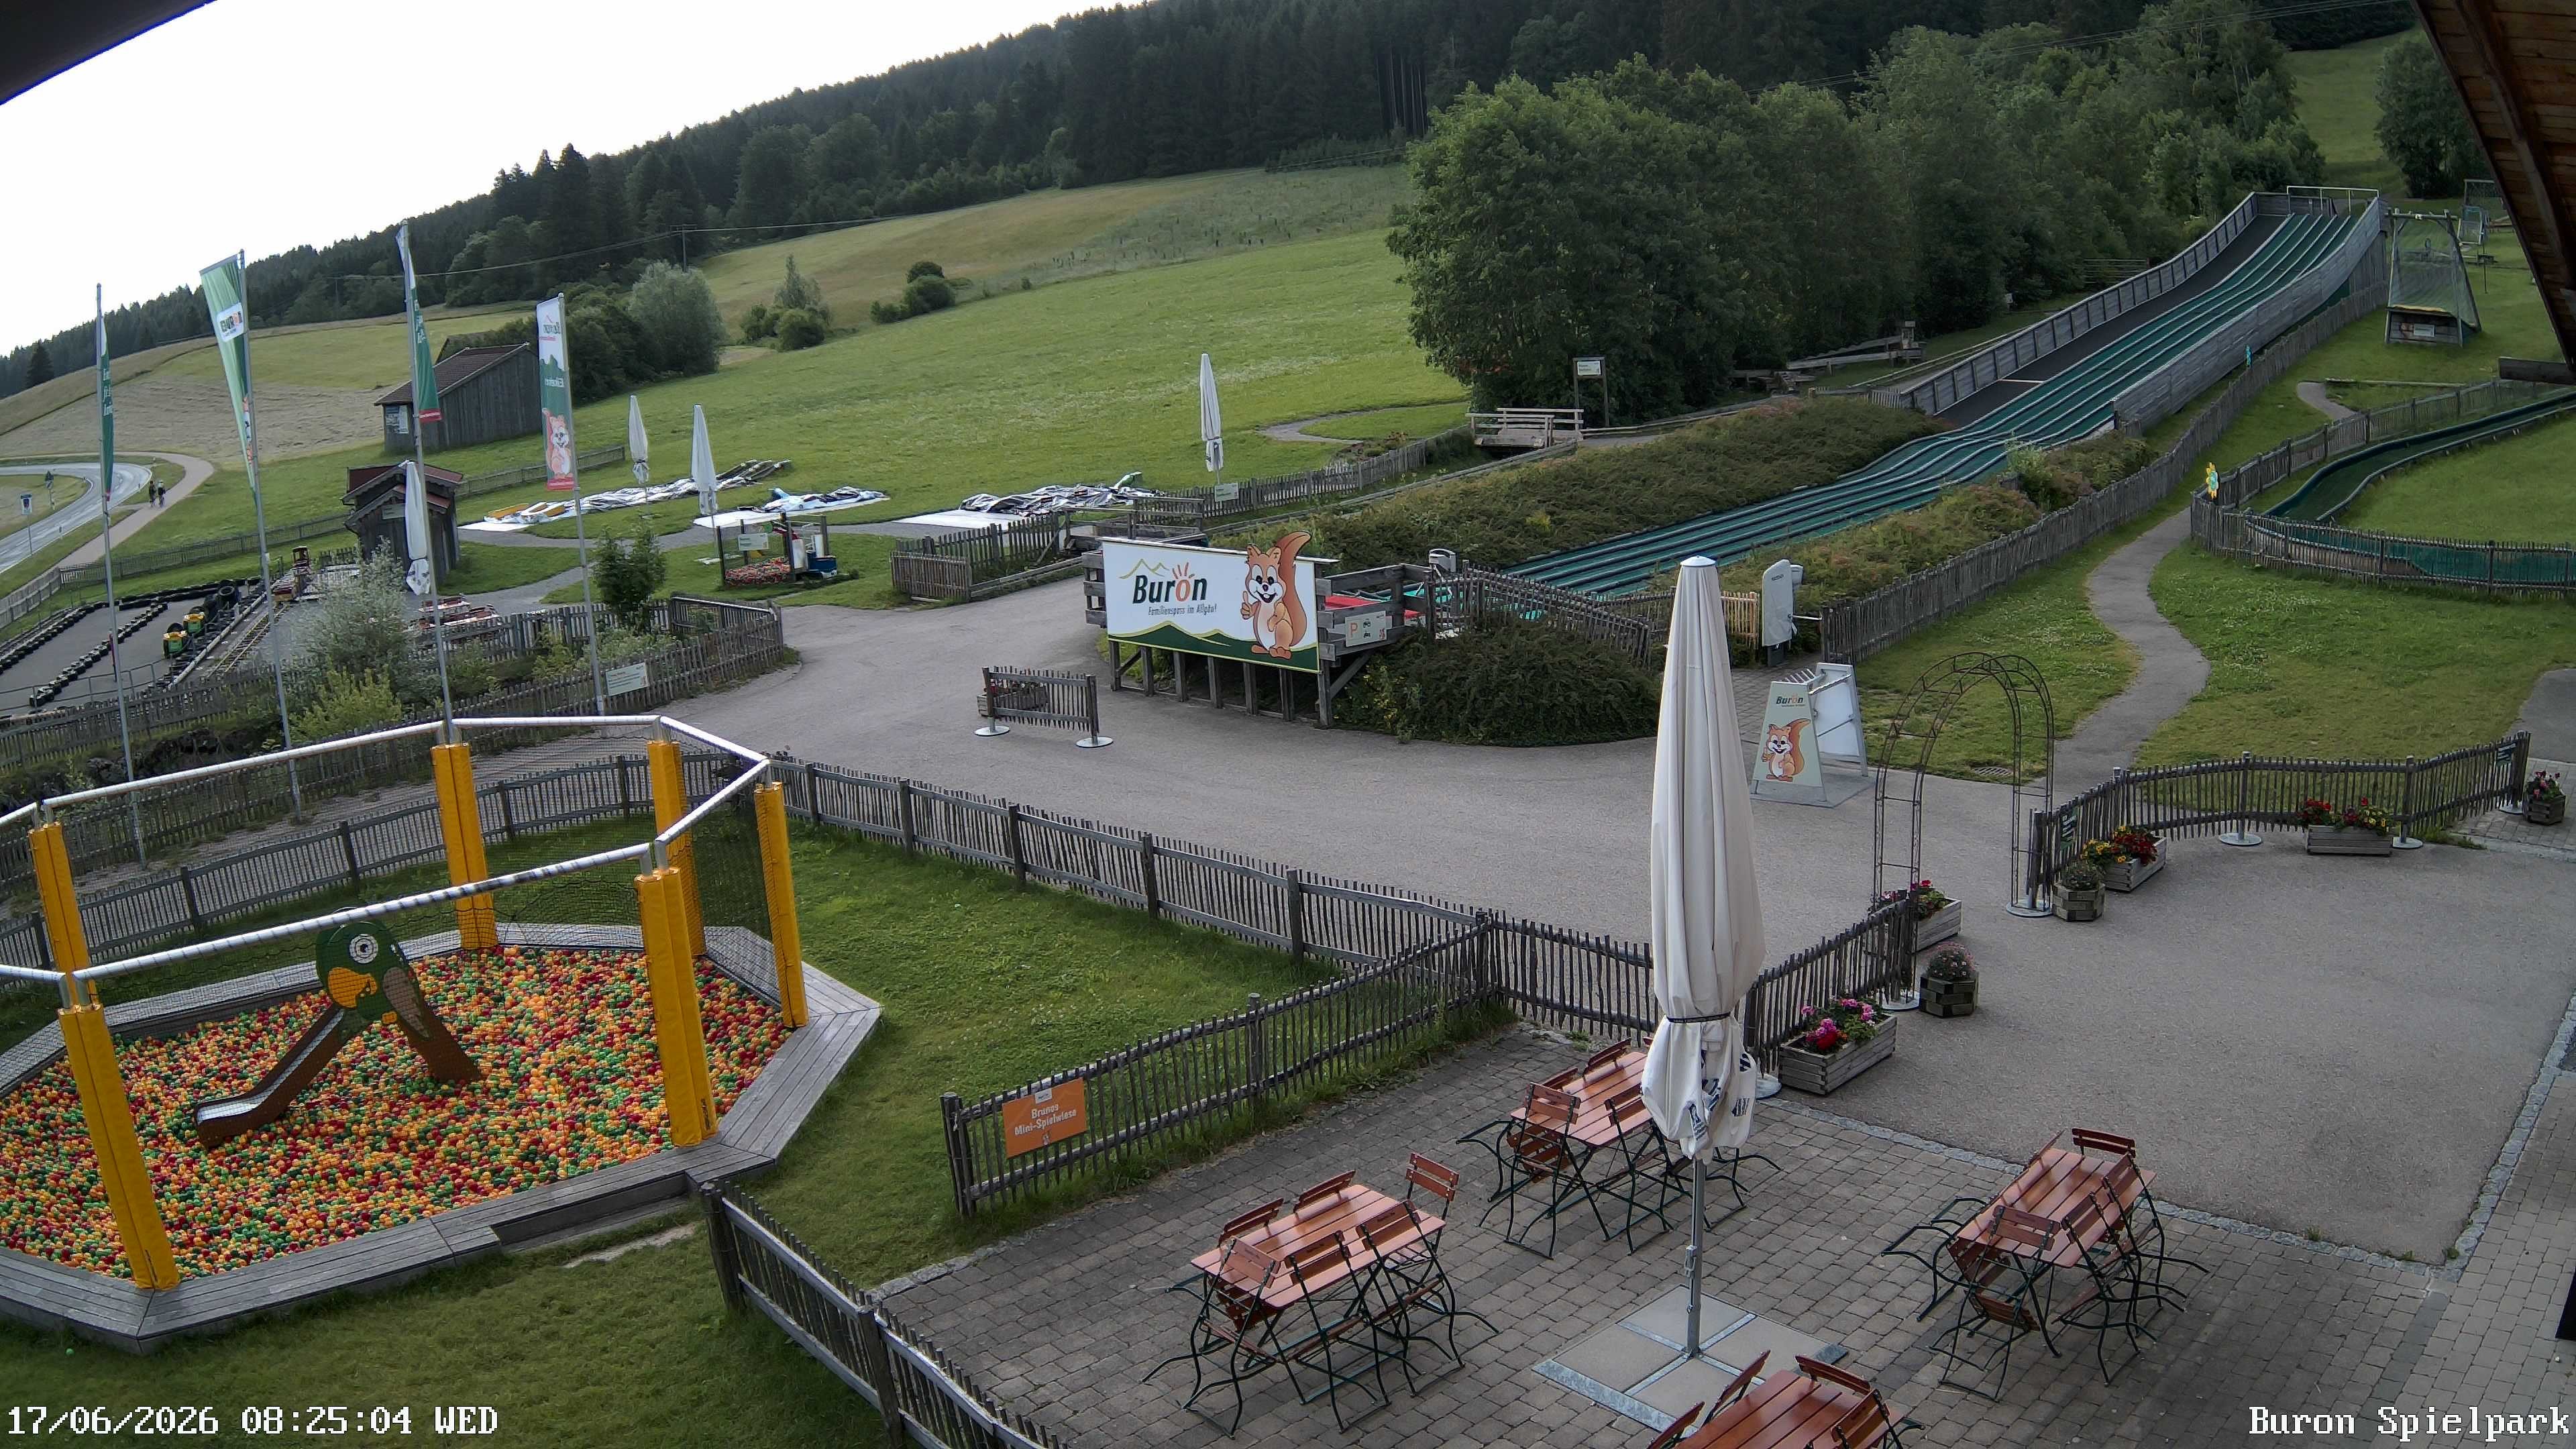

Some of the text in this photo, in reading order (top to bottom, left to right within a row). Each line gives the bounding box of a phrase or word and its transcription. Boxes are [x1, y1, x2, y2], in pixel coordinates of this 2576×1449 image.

[1132, 574, 1208, 604] Buron
[1350, 622, 1358, 638] P
[1776, 696, 1804, 704] Buron
